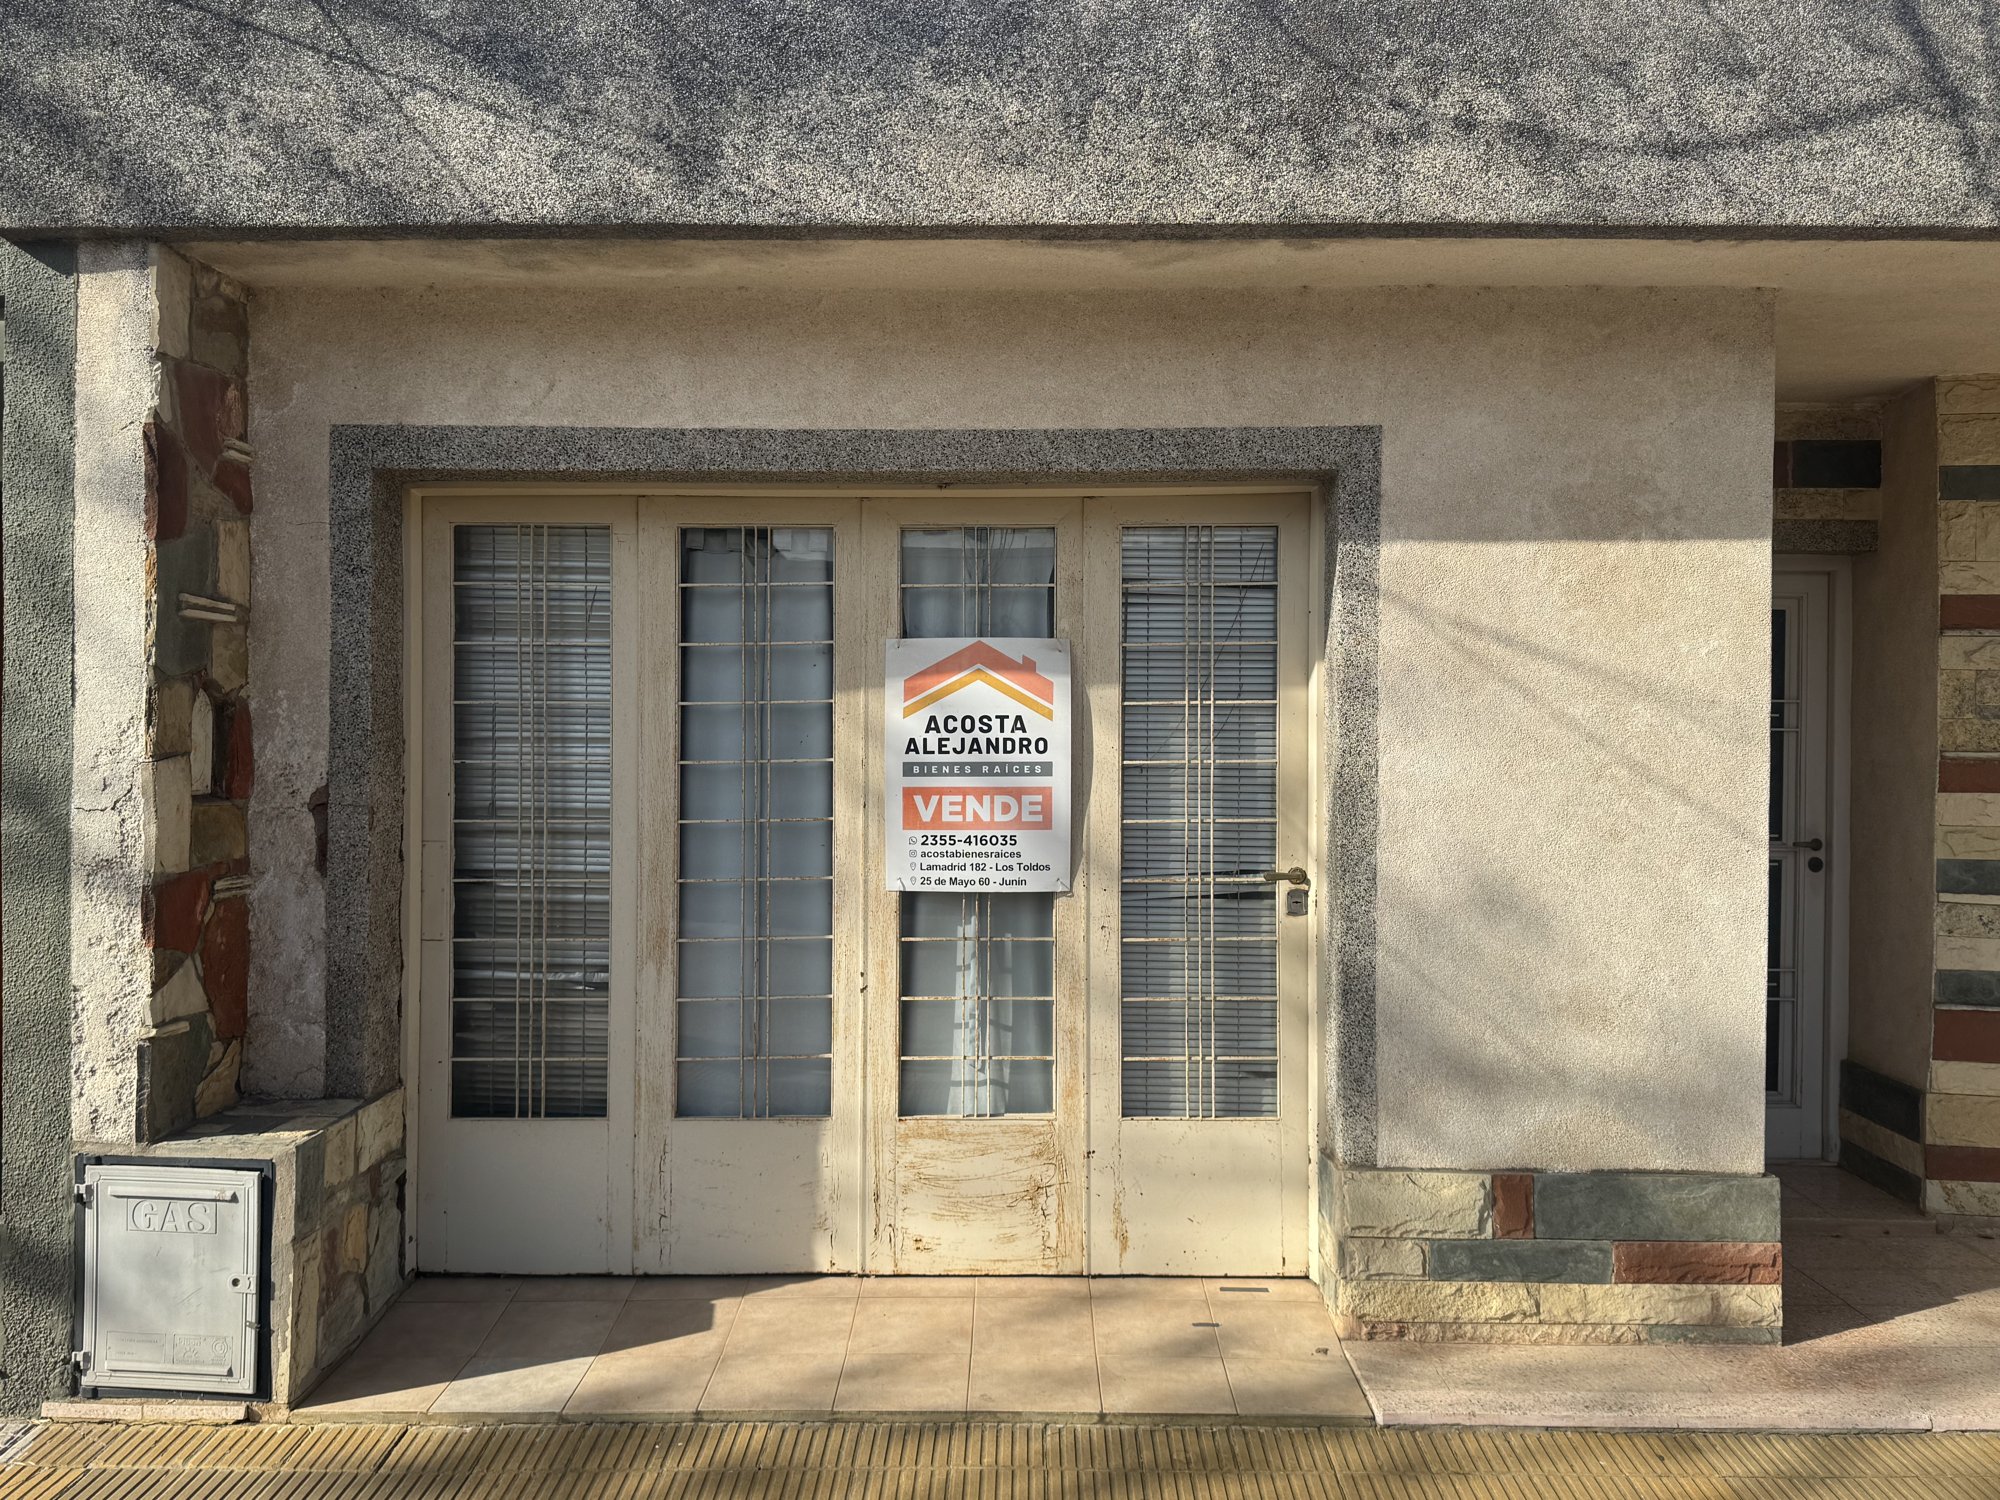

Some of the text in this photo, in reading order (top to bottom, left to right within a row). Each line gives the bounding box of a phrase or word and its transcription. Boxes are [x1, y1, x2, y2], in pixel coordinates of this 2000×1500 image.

[924, 714, 1027, 734] ACOSTA
[904, 737, 1048, 755] ALEJANDRO
[913, 764, 1042, 774] BIENES RAÍCES
[913, 795, 1043, 822] VENDE
[920, 834, 1017, 847] 2355-416035
[920, 862, 967, 872] Lamadrid
[969, 862, 987, 872] 182
[995, 862, 1014, 872] Los
[1016, 862, 1051, 872] Toldos
[920, 876, 932, 886] 25
[934, 876, 946, 886] de
[949, 876, 976, 888] Mayo
[978, 877, 990, 886] 60
[999, 876, 1027, 886] Junín
[132, 1200, 212, 1233] GAS
